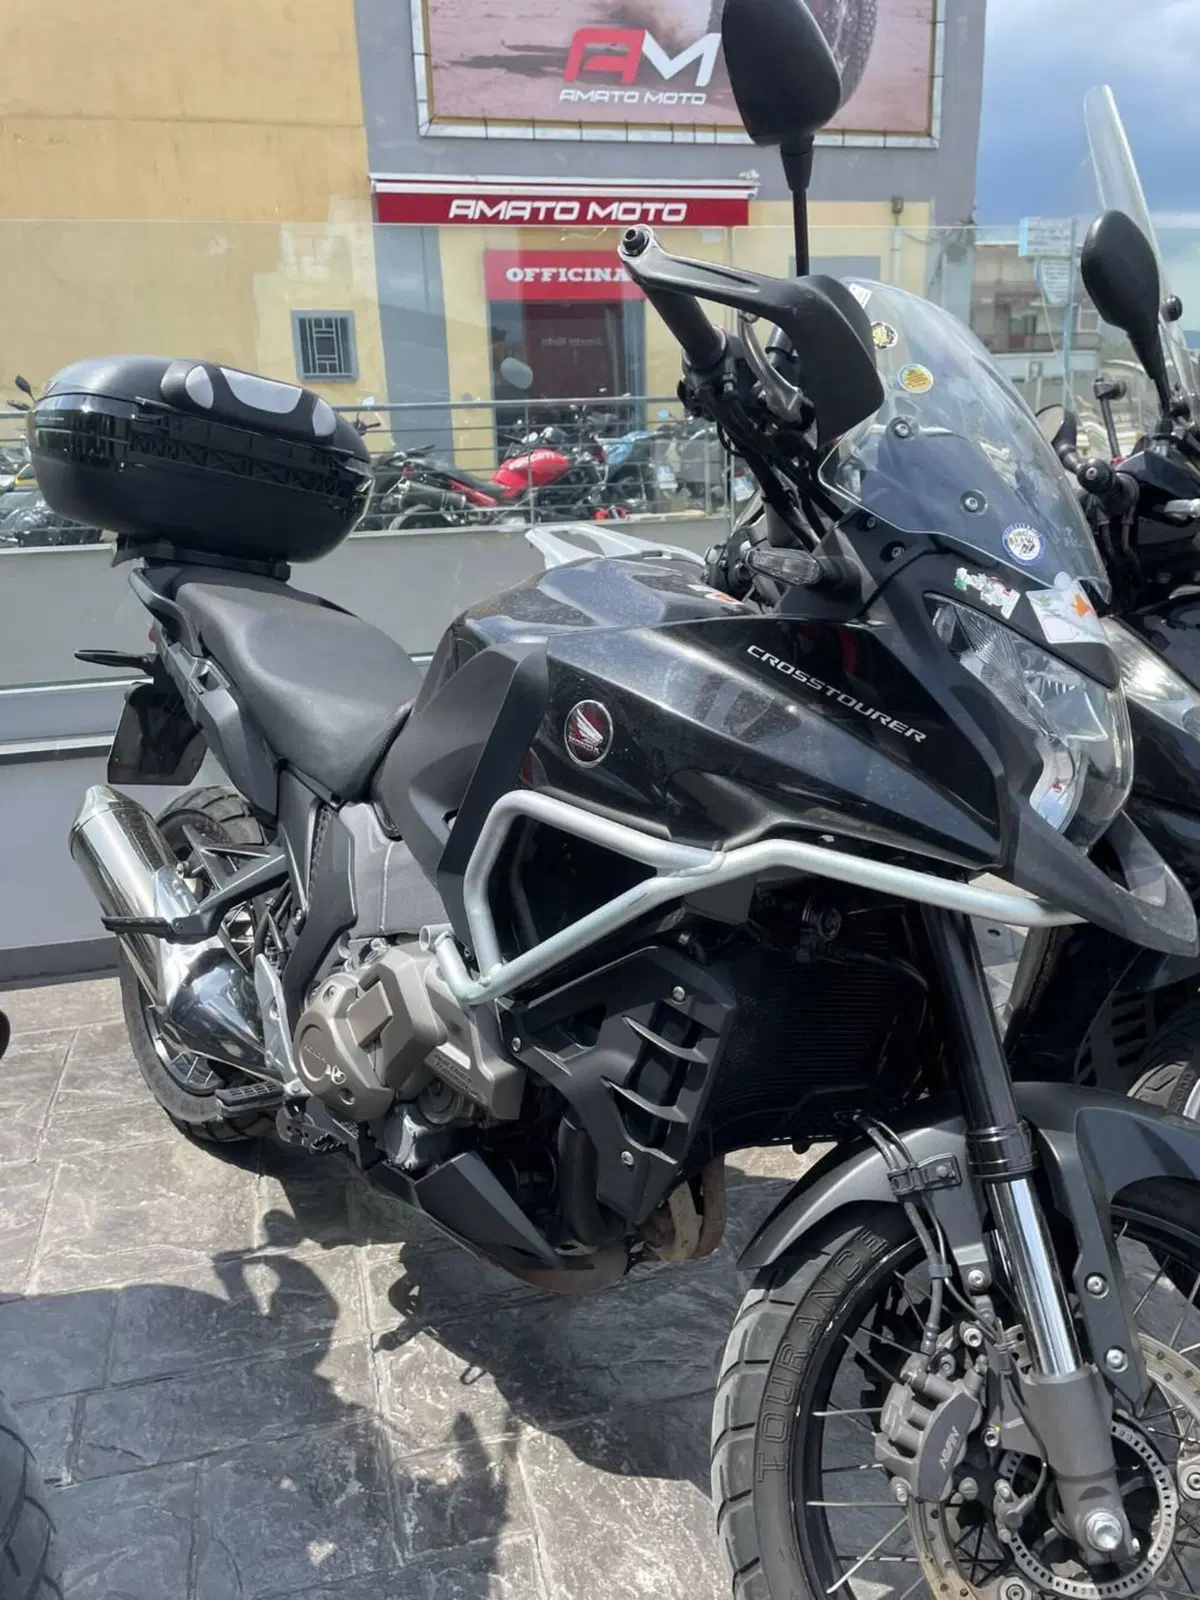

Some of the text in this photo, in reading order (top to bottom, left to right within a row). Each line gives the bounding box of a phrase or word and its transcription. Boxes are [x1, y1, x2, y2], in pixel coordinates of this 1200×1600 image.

[563, 27, 722, 86] AM
[560, 88, 707, 106] AMATO MOTO
[449, 199, 687, 222] AMATO MOTO
[505, 266, 633, 283] OFFICINA
[747, 645, 927, 743] CROSSTOURER
[754, 1225, 888, 1482] TOURANCE
